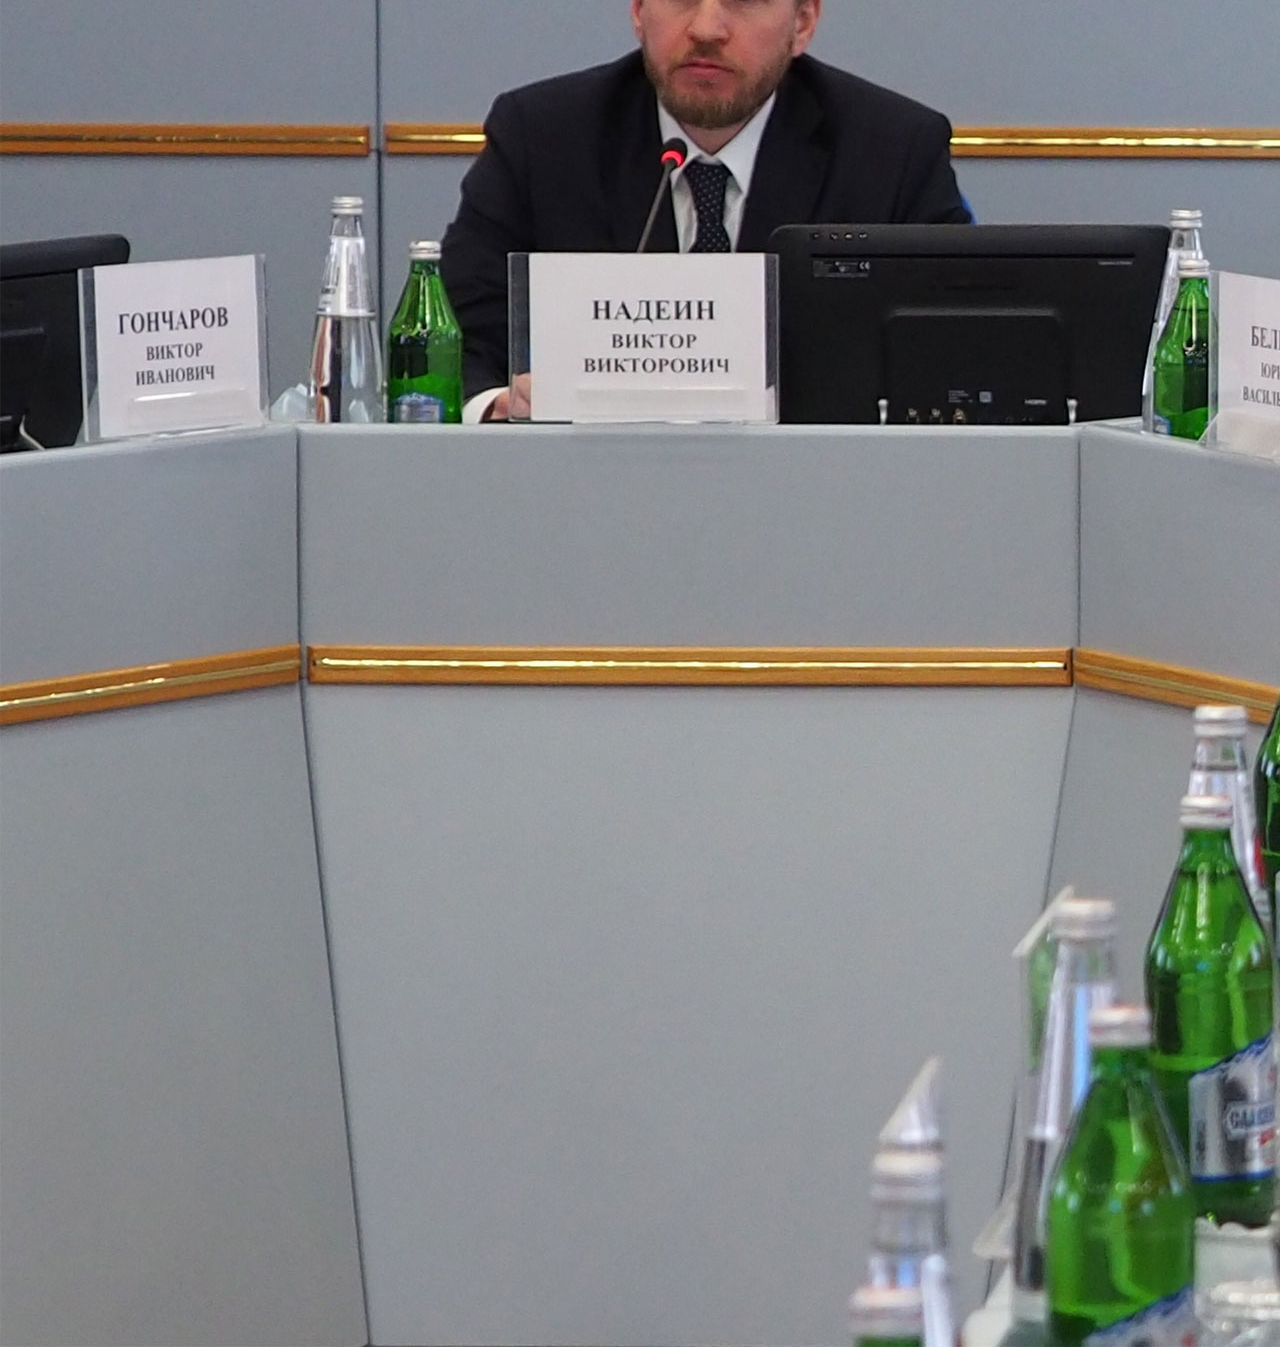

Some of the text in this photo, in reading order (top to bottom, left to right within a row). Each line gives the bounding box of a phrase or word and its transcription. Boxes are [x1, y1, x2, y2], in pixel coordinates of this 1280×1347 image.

[118, 306, 229, 335] ГОНЧАРОВ
[592, 299, 715, 324] НАДЕИН
[612, 333, 697, 349] ВИКТОР
[146, 342, 203, 361] ВИКТОР
[136, 365, 215, 386] ИВАНОВИЧ
[584, 358, 729, 373] ВИКТОРОВИЧ
